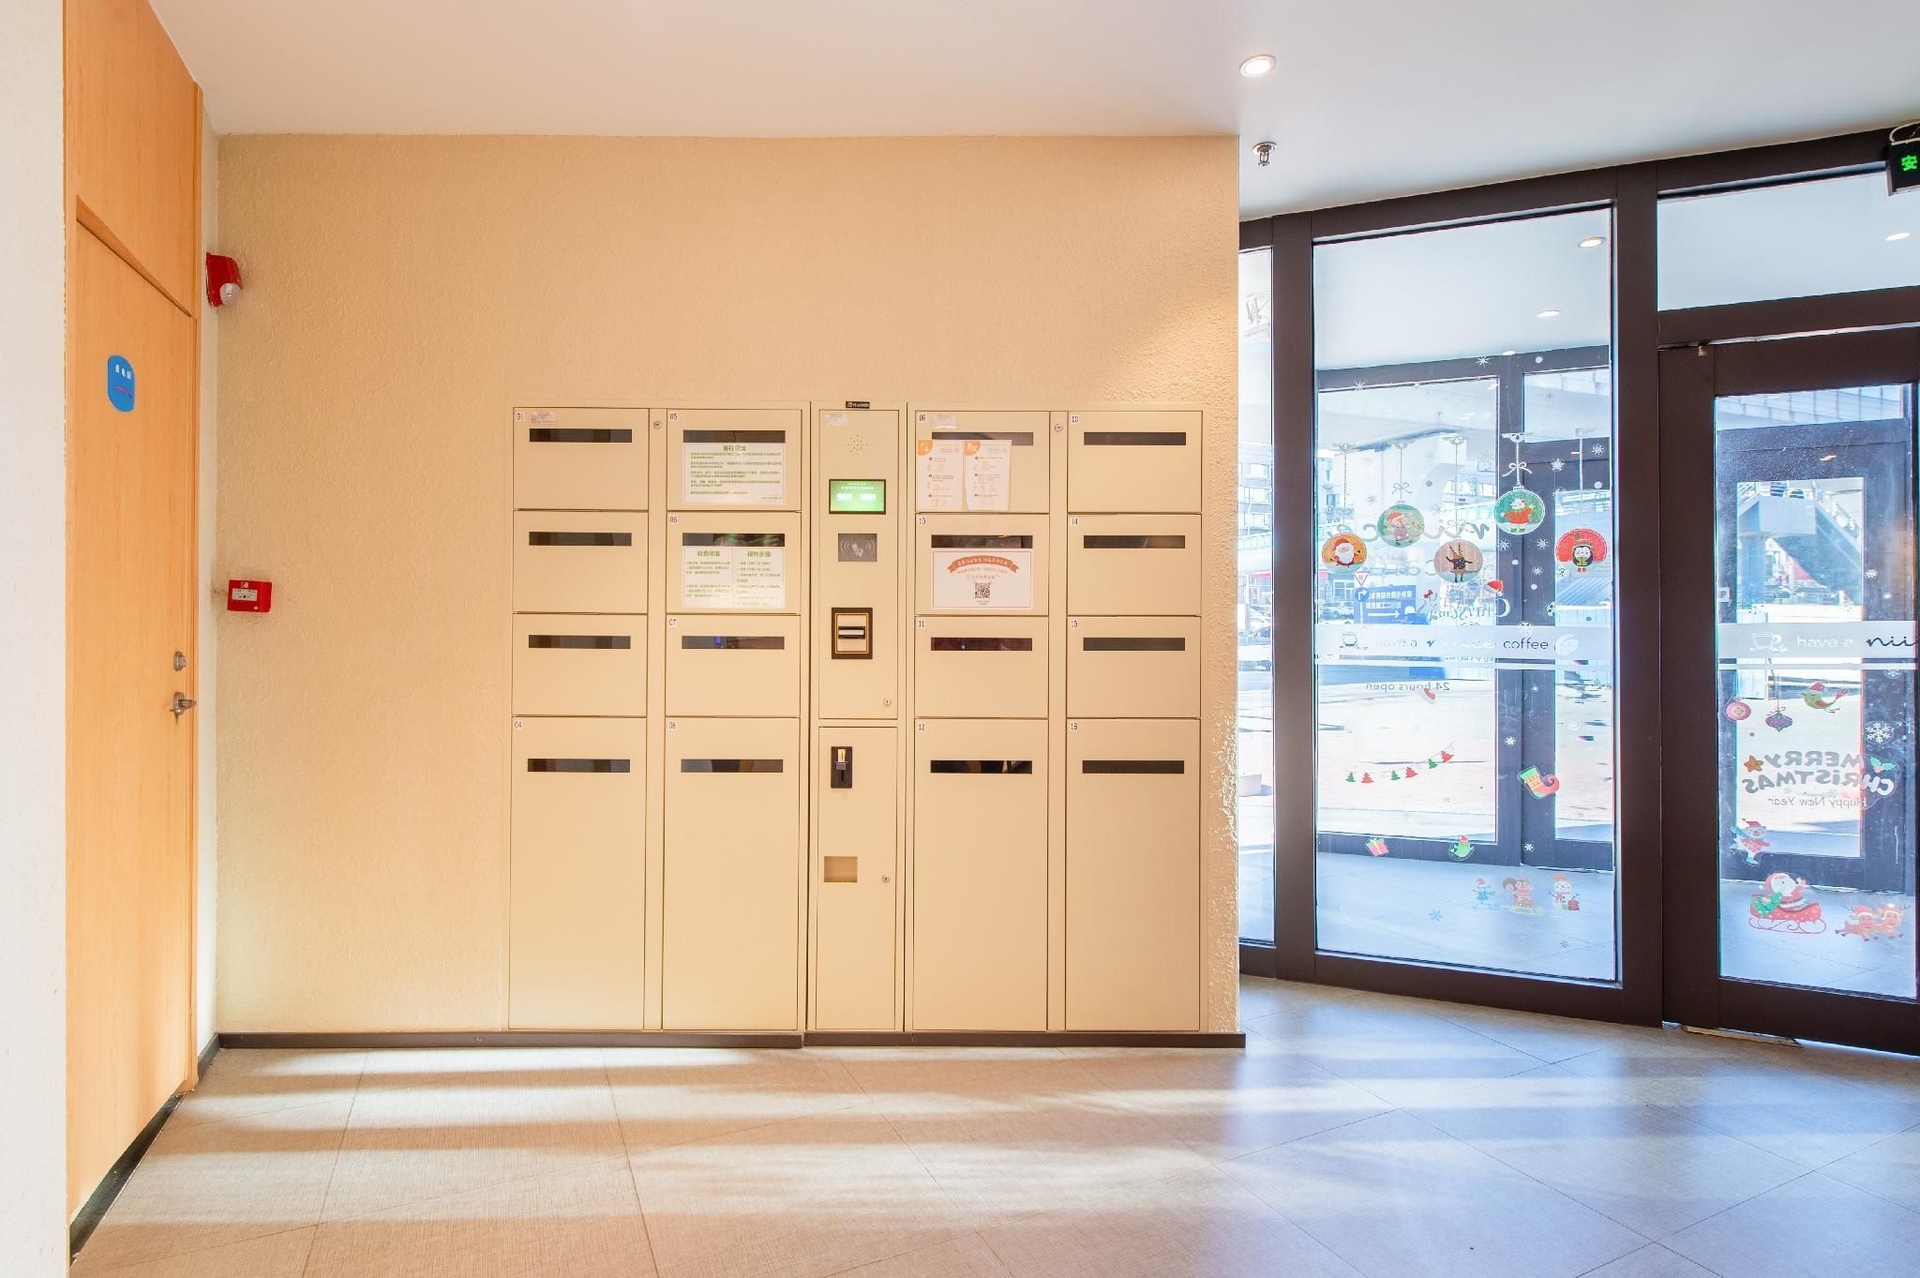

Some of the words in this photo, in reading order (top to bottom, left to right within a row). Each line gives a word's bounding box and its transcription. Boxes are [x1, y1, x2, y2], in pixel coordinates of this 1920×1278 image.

[1901, 154, 1918, 172] 安
[669, 412, 678, 421] 05
[669, 515, 678, 524] 06
[1071, 517, 1079, 525] 14
[668, 618, 677, 626] 07
[918, 620, 925, 628] 11
[1502, 636, 1549, 650] coffee
[1796, 635, 1838, 648] have
[918, 723, 926, 731] 12
